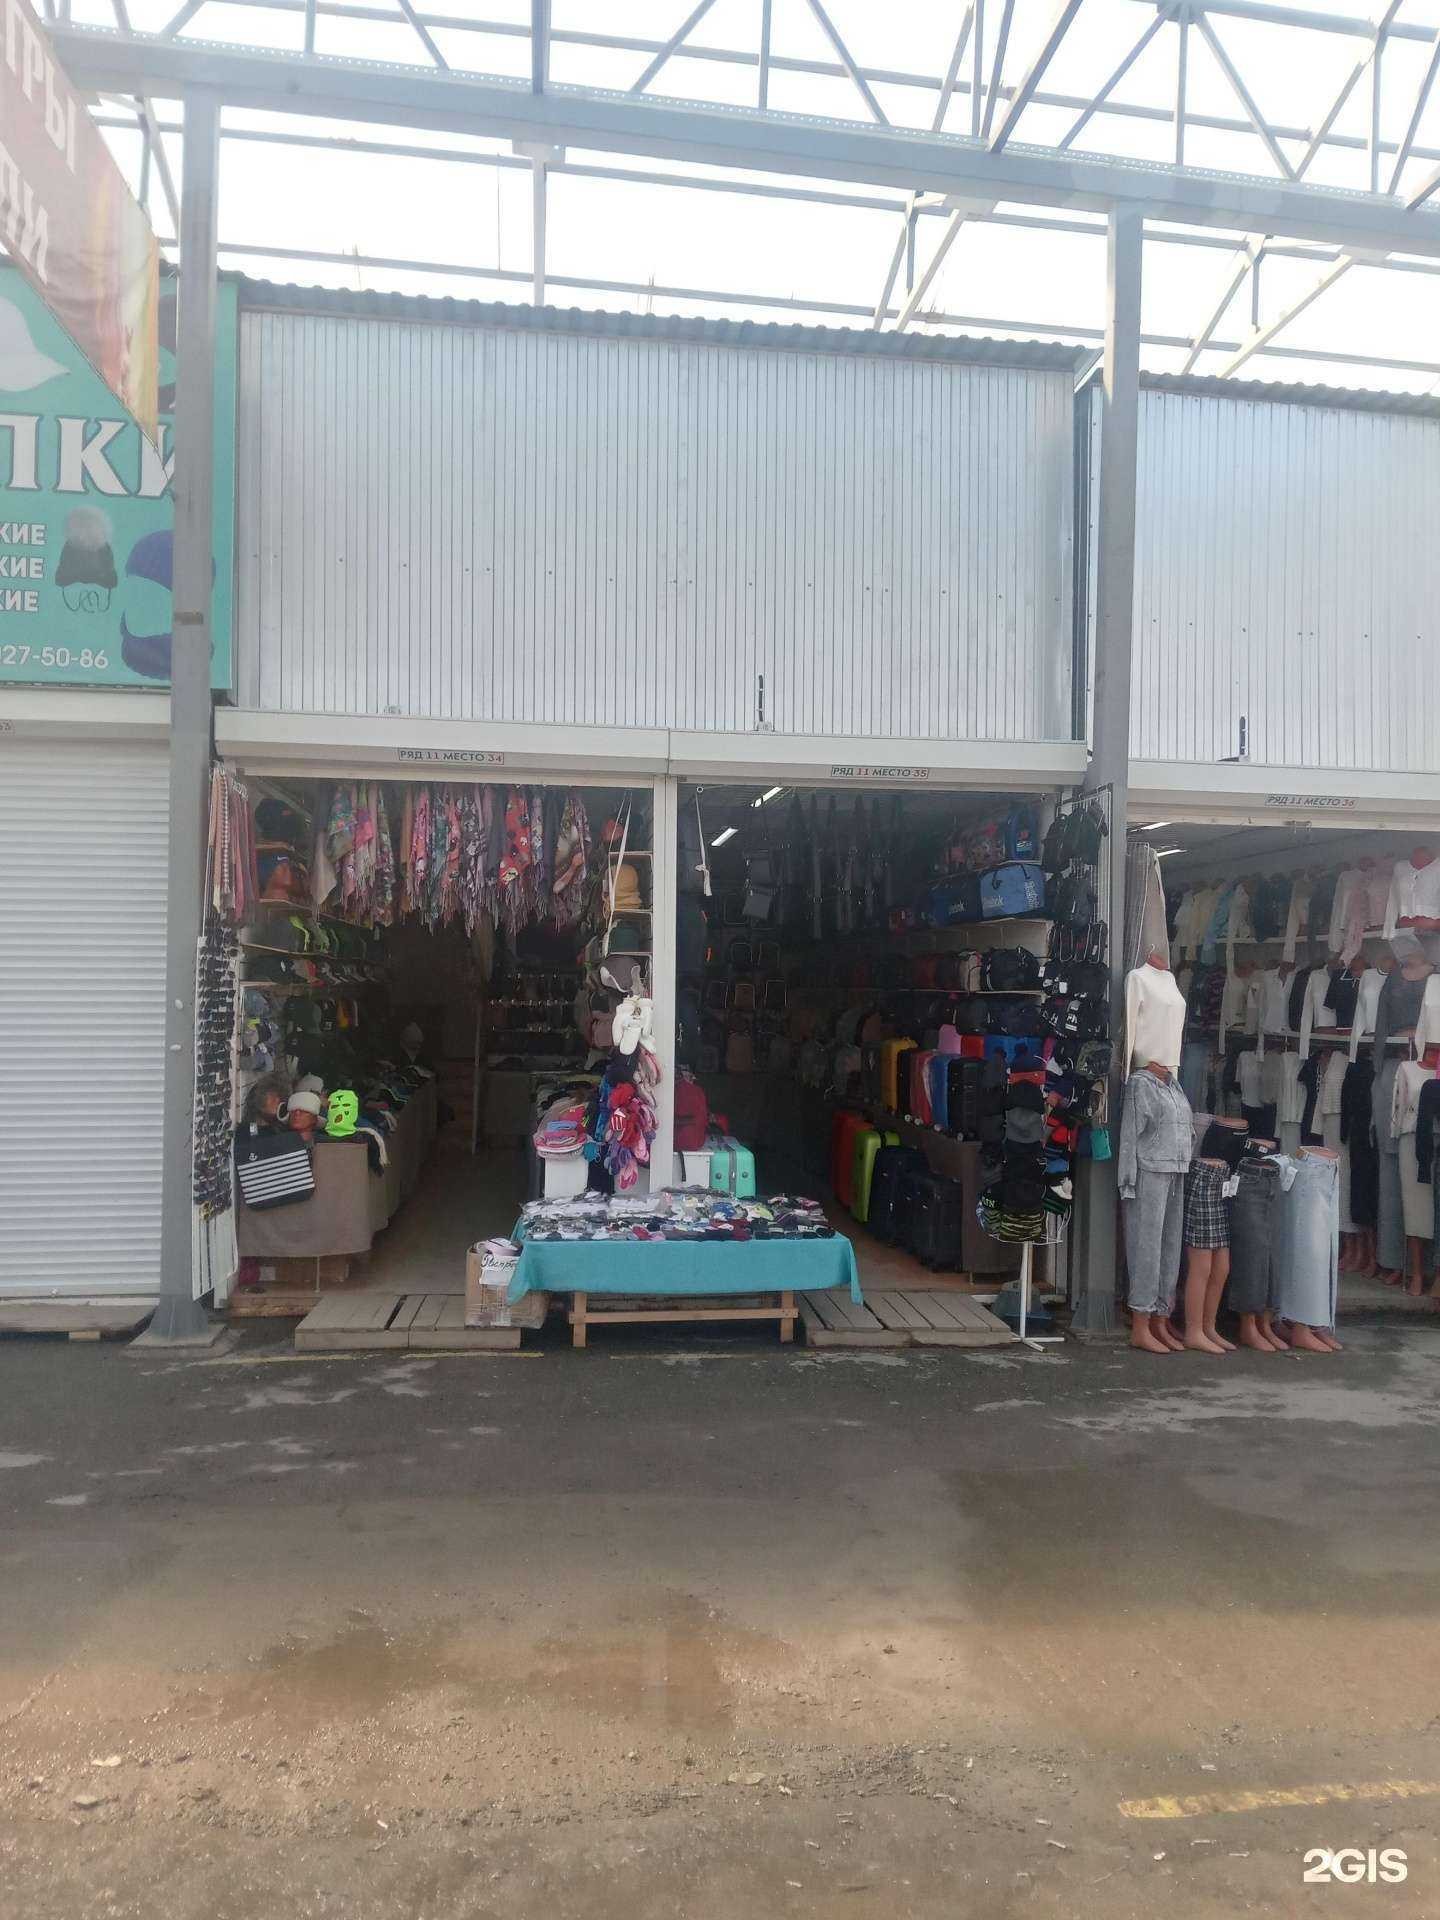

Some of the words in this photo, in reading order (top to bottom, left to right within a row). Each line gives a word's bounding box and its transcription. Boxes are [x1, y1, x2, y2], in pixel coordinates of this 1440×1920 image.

[0, 589, 39, 612] ИЕ
[0, 644, 109, 669] 27-50-86
[400, 750, 423, 760] РЯД
[426, 751, 439, 760] 11
[443, 752, 485, 762] МЕСТО
[833, 767, 854, 777] РЯД
[856, 767, 869, 776] 11
[872, 768, 911, 777] МЕСТО
[1267, 796, 1288, 804] РЯД
[1304, 797, 1340, 806] МЕСТО
